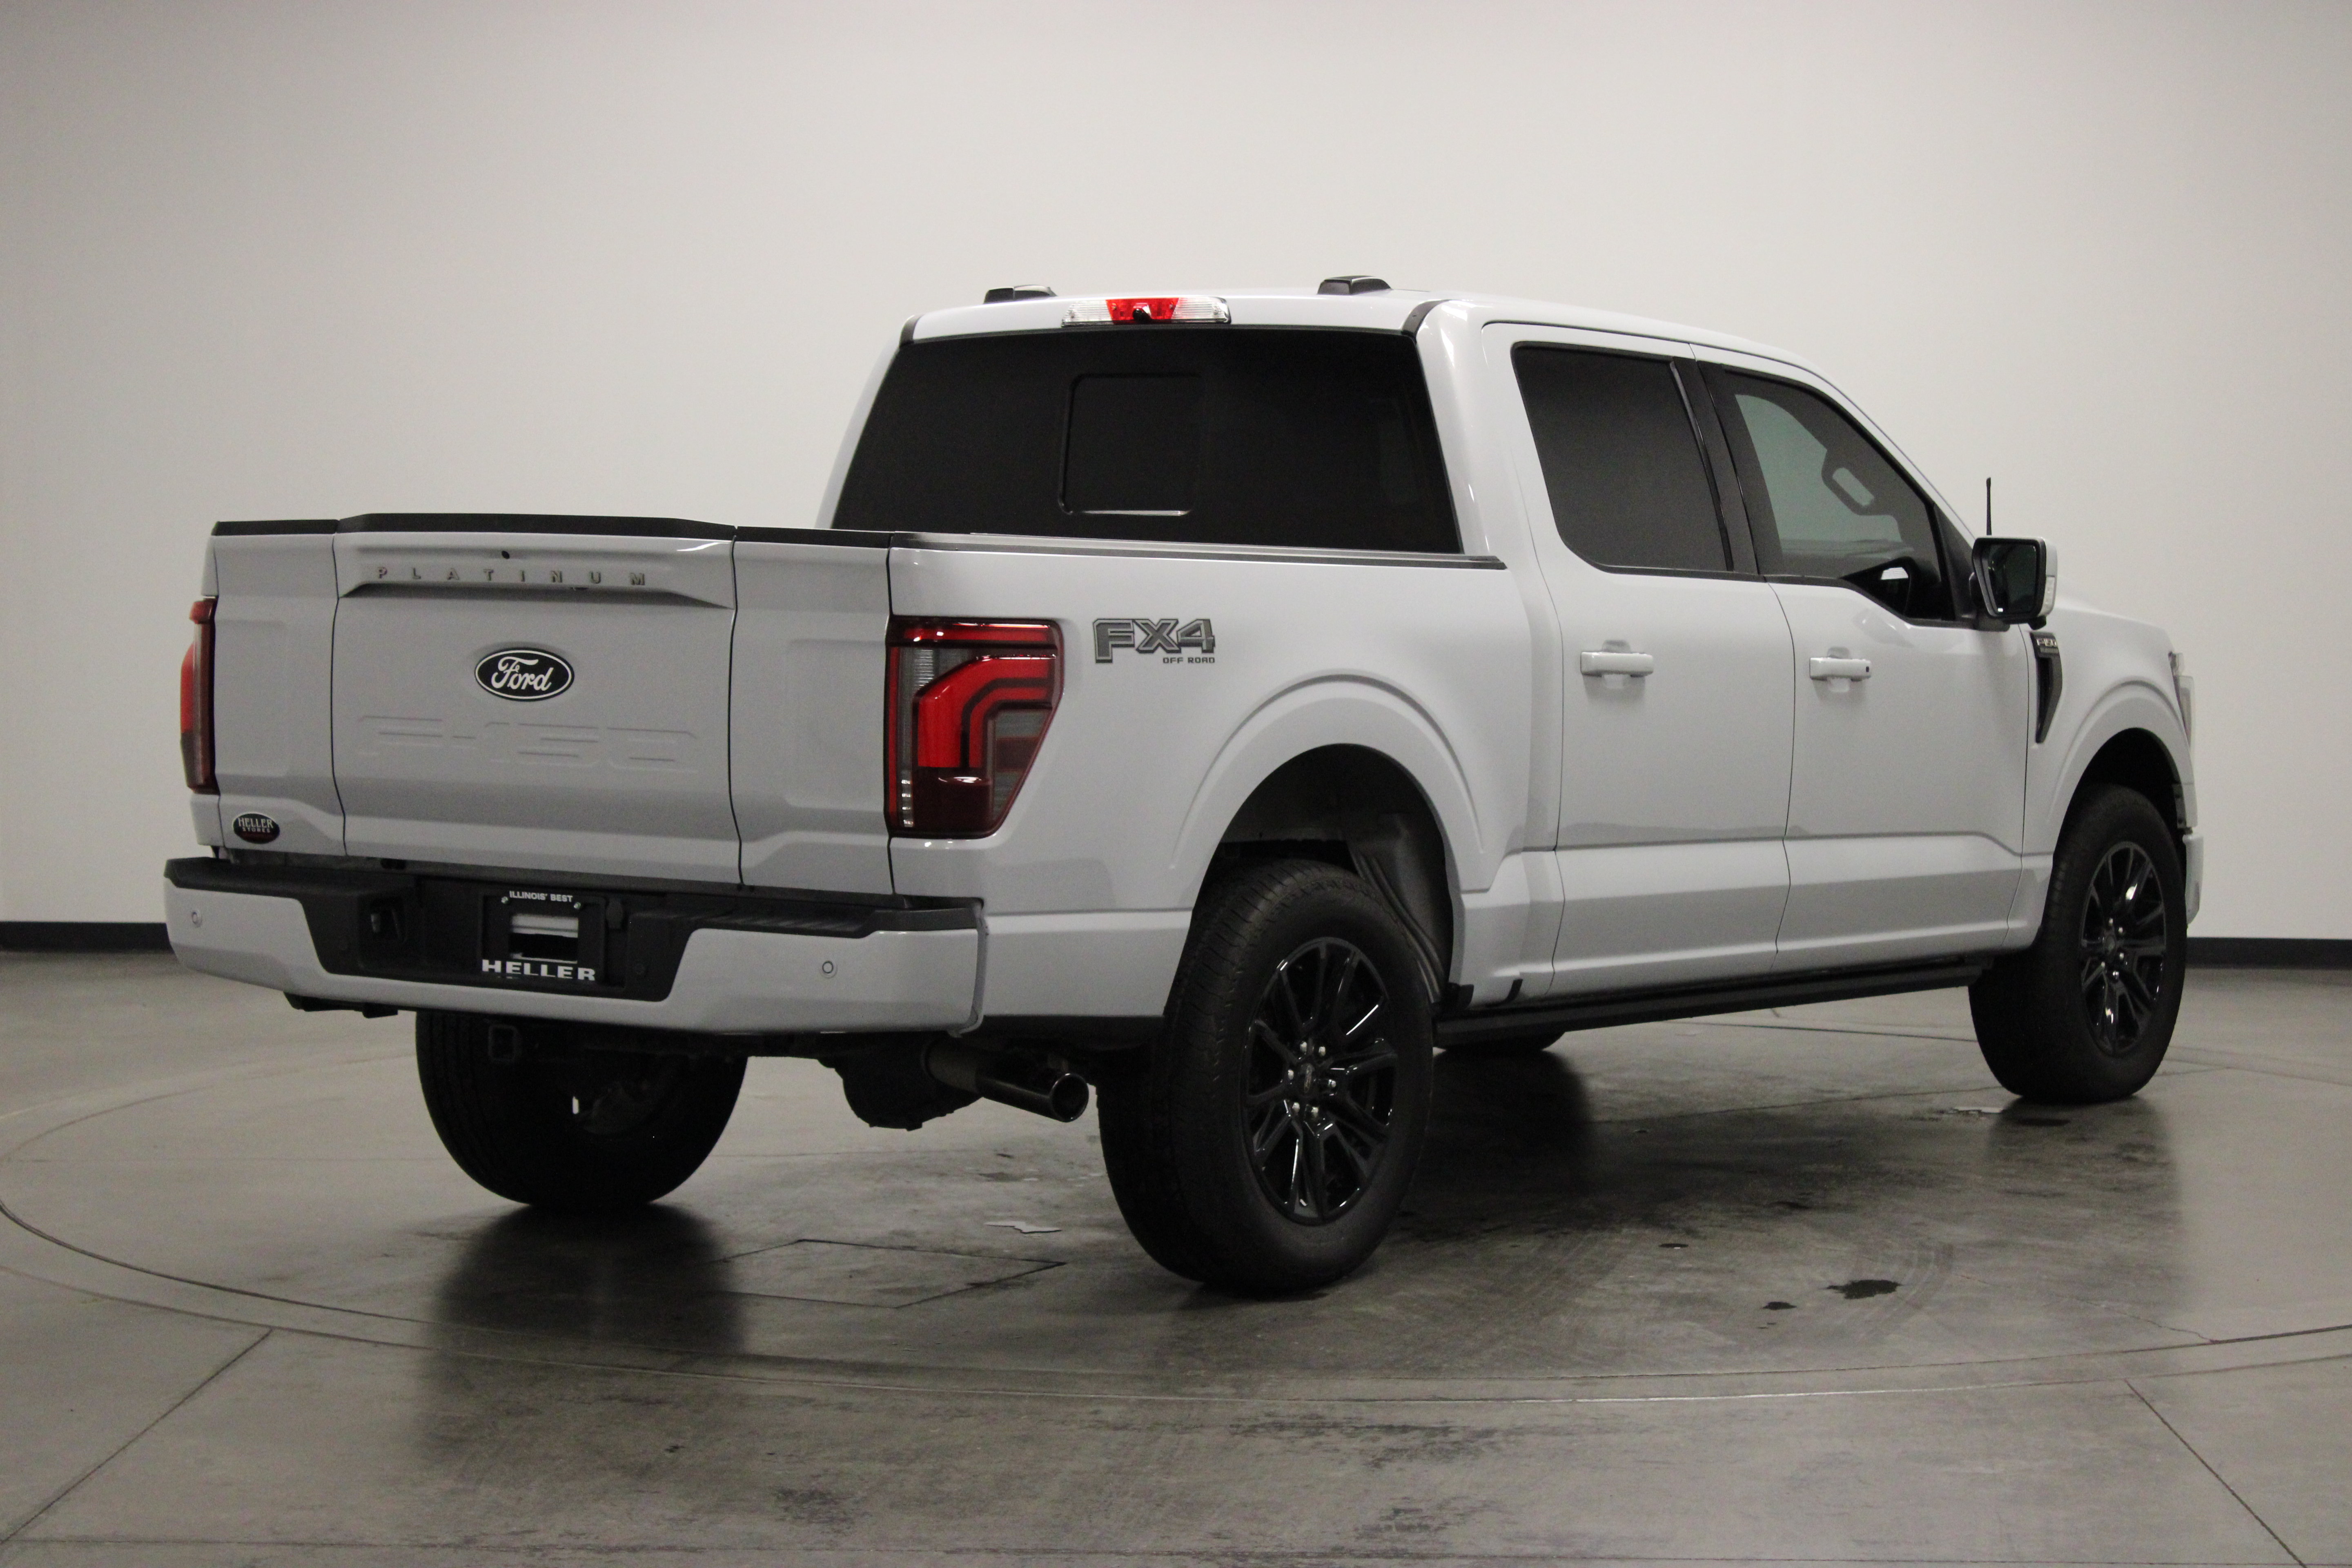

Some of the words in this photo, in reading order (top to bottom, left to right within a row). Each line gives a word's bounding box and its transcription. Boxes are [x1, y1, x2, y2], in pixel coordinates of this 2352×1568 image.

[378, 567, 646, 586] PLATINUM
[1093, 618, 1215, 664] FX4
[491, 656, 554, 691] Ford
[237, 817, 274, 829] HELLER
[509, 891, 548, 901] ILLINOIS'
[550, 893, 573, 902] BEST
[482, 959, 595, 981] HELLER
